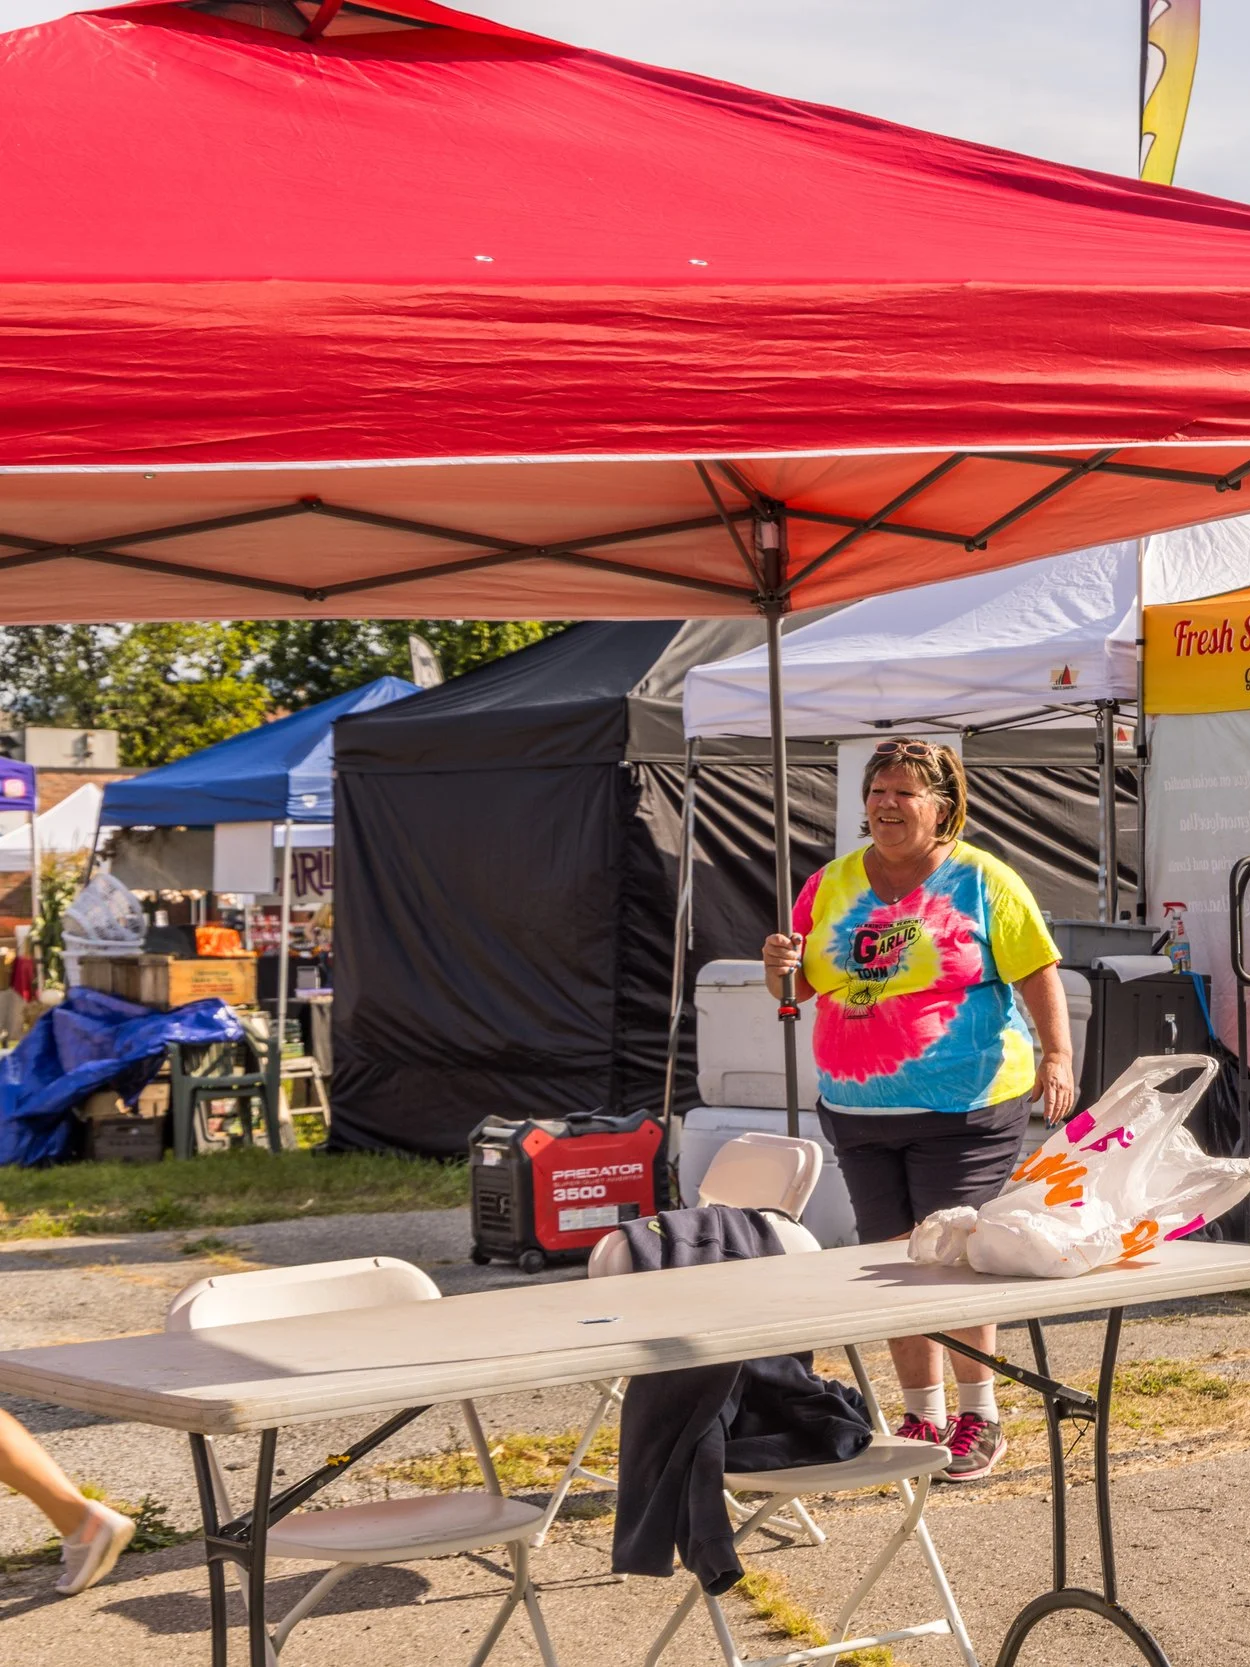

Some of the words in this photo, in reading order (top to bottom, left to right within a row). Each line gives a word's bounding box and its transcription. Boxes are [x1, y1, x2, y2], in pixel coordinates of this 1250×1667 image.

[1174, 619, 1235, 657] Fresh
[853, 926, 917, 964] GARLIC
[855, 966, 889, 979] TOWN
[552, 1163, 643, 1180] PREDATOR
[552, 1185, 607, 1202] 3500
